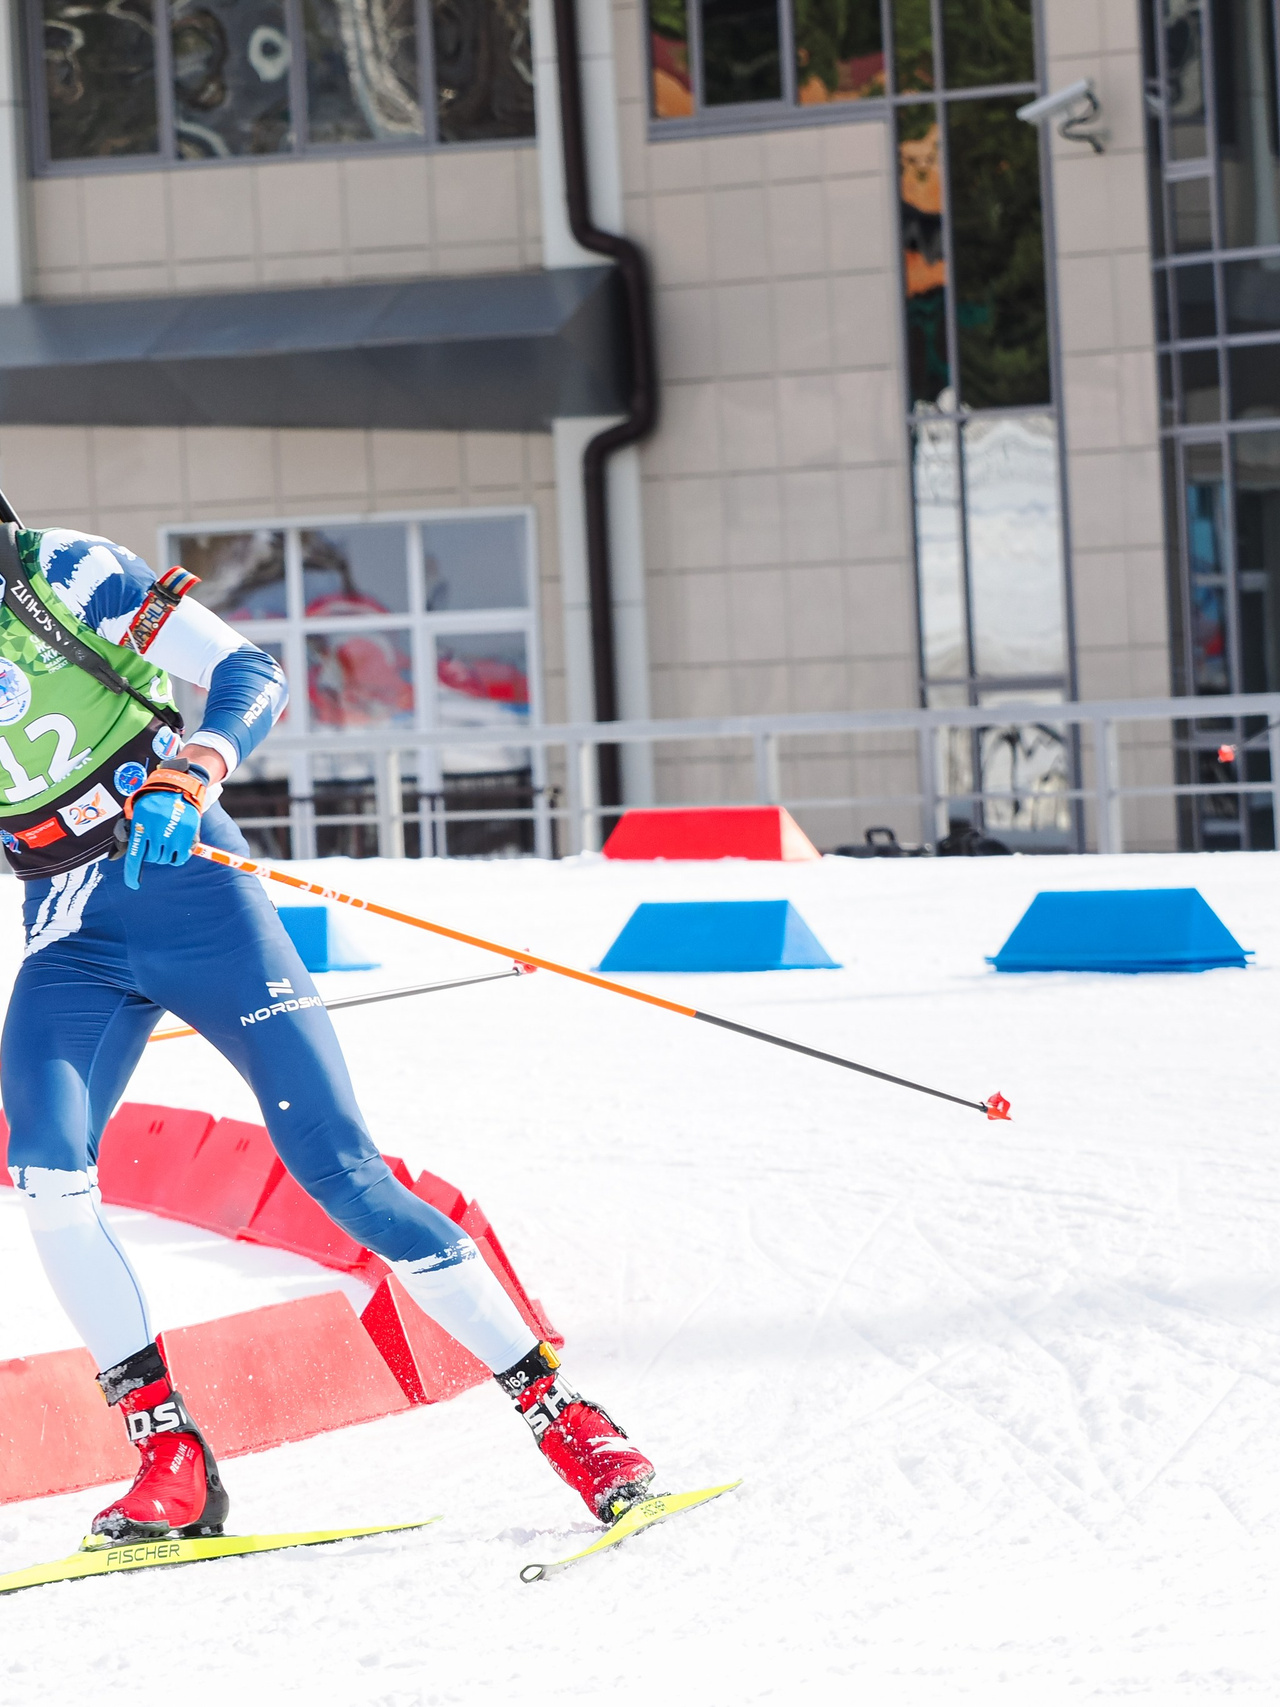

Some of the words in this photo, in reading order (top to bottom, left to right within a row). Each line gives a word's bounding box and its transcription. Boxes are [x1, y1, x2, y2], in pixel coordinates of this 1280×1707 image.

[505, 1370, 530, 1390] 162
[169, 1441, 188, 1475] REDLINE
[107, 1544, 180, 1567] FISCHER
